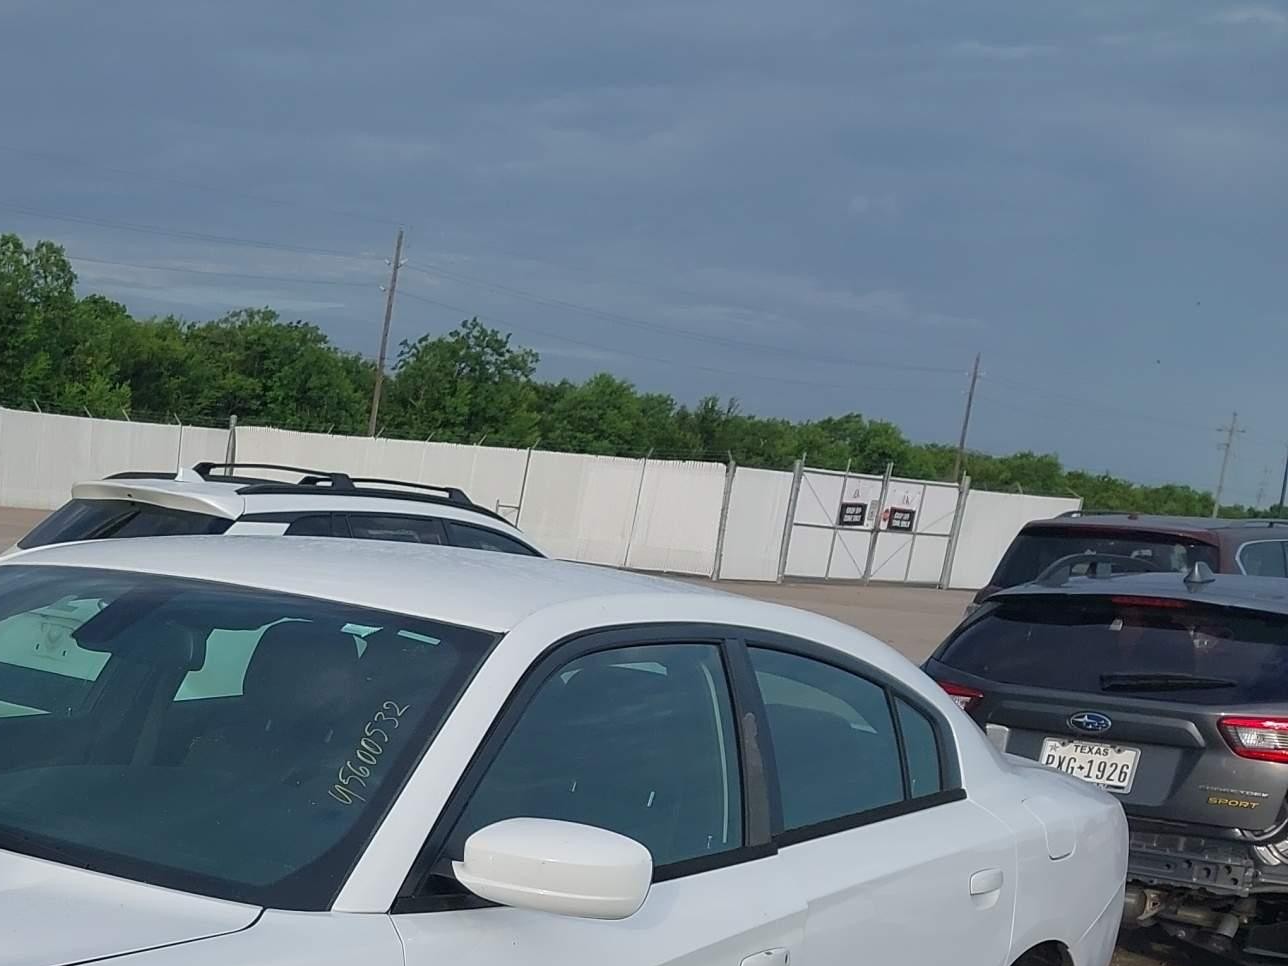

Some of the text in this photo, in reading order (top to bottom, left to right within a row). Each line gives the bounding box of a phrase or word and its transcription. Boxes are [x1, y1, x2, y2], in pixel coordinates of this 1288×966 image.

[327, 700, 410, 804] 45600532
[1073, 744, 1110, 757] TEXAS
[1207, 797, 1260, 809] SPORT
